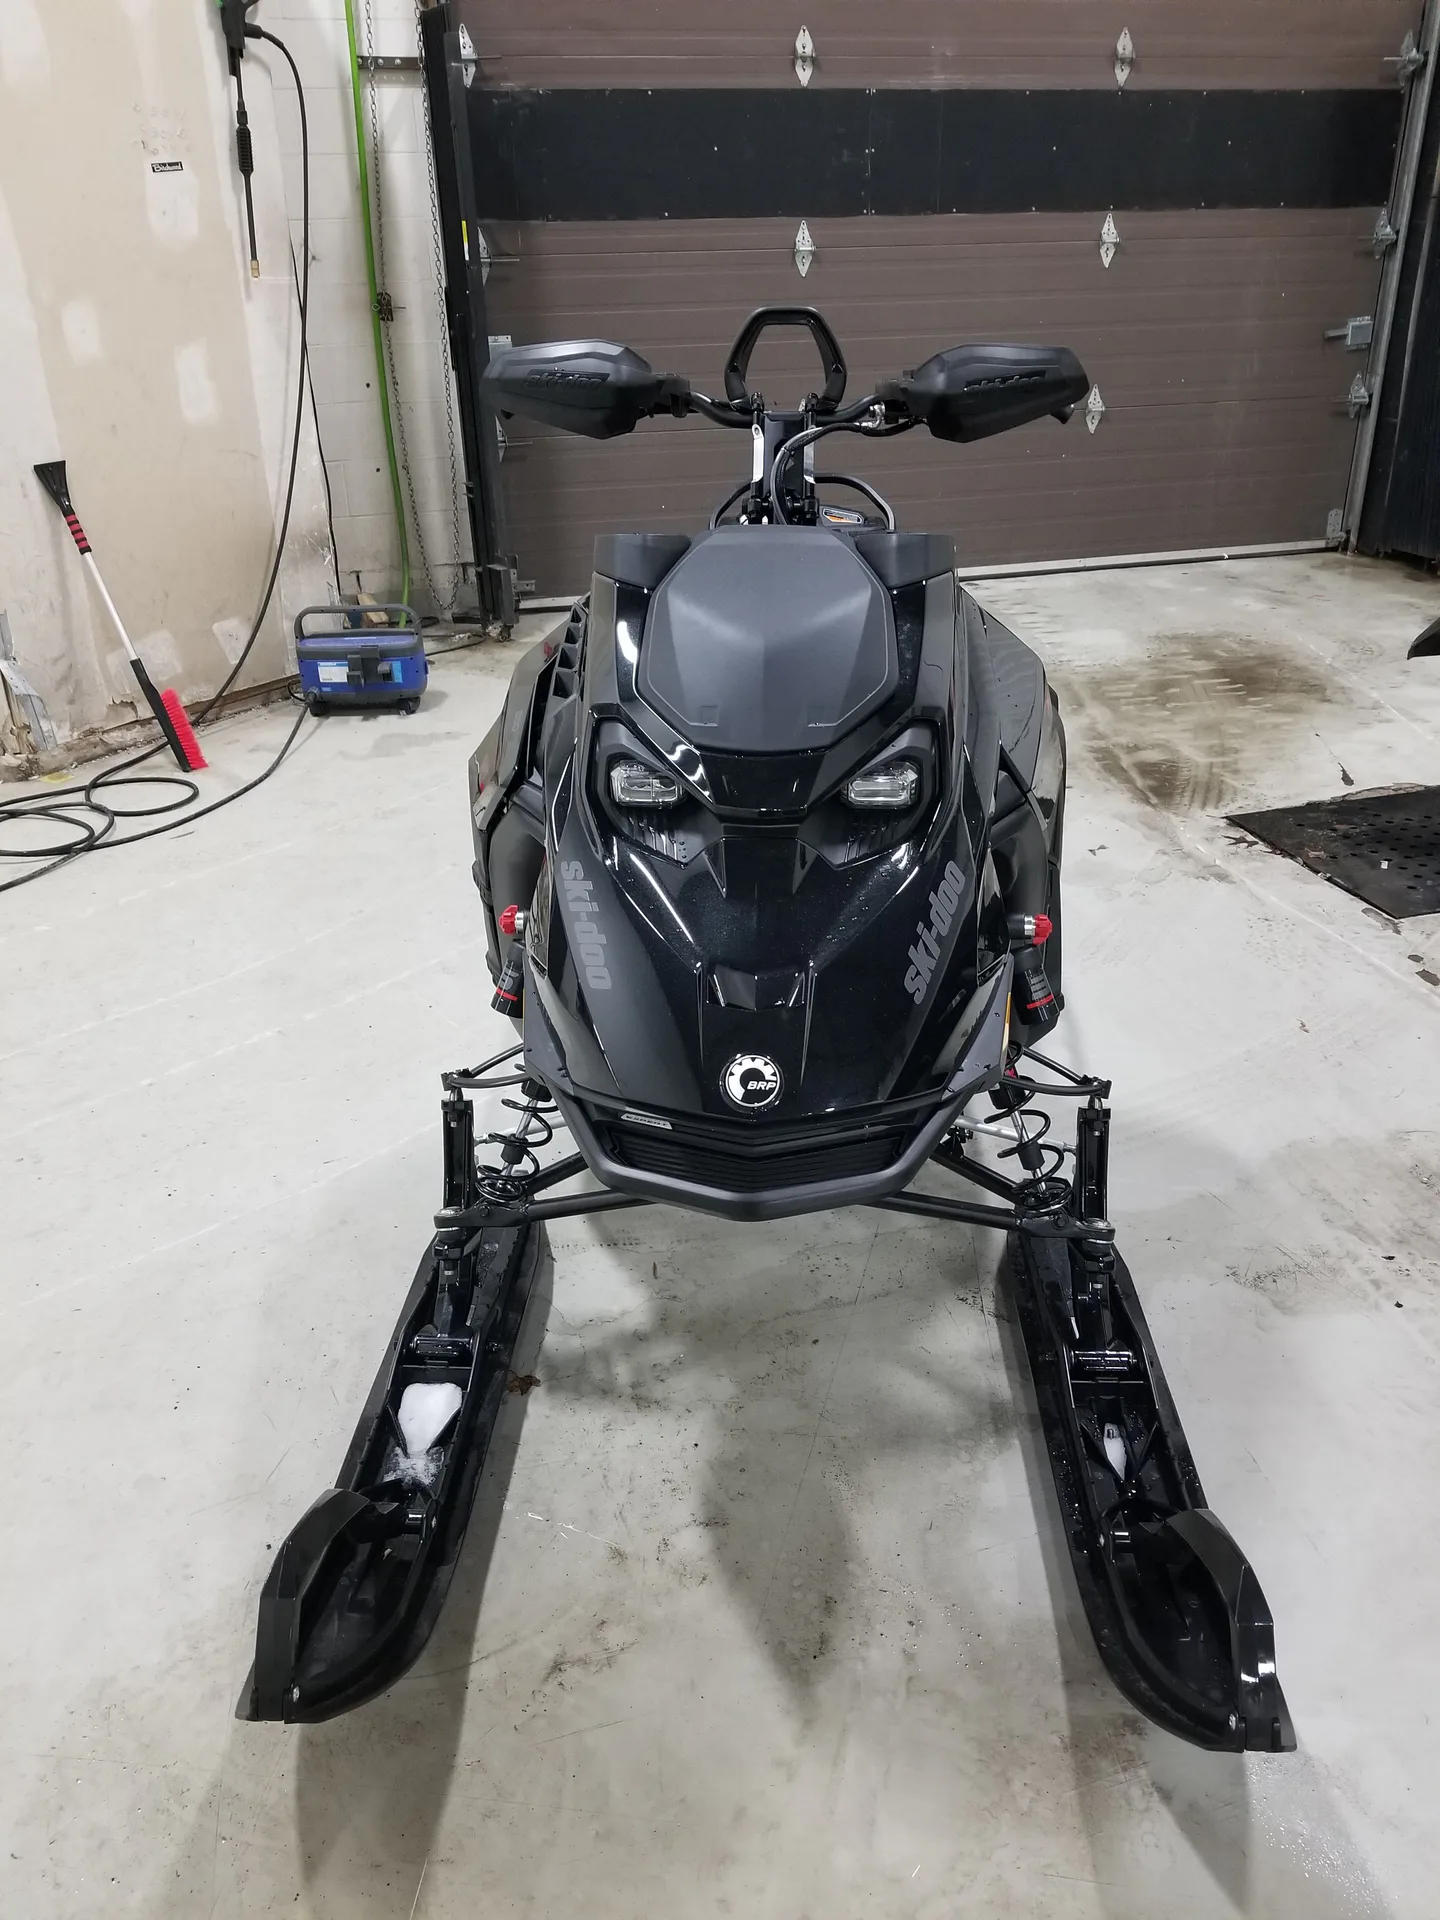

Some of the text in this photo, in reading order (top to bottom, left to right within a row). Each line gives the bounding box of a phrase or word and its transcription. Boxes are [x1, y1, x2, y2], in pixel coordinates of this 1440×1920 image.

[560, 860, 612, 990] ski-doo
[904, 860, 966, 1005] ski-doo
[747, 1081, 777, 1091] BRP
